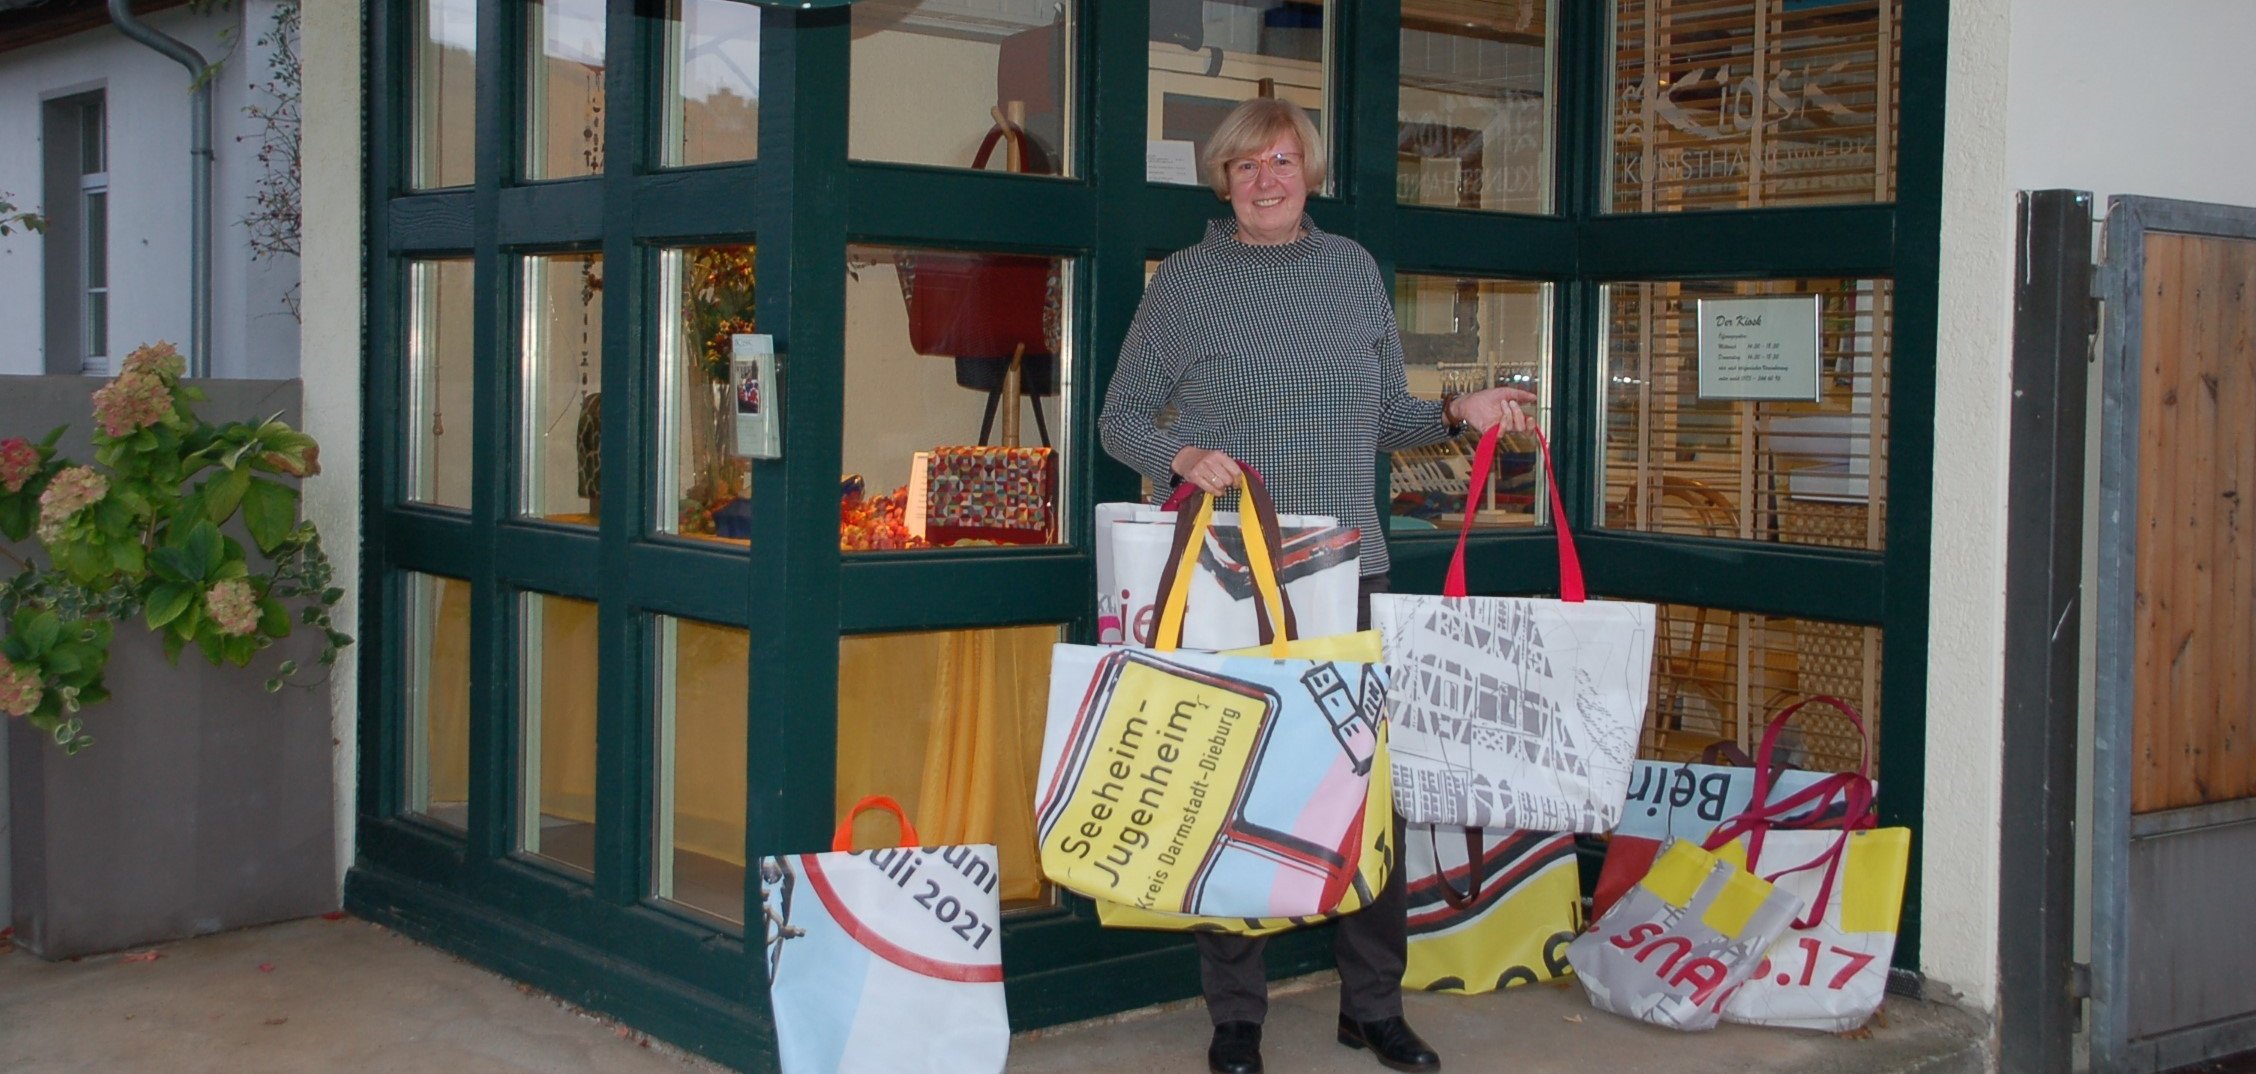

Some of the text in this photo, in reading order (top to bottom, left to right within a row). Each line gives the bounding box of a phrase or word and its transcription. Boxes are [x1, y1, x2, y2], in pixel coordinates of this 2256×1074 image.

[1715, 315, 1762, 327] Der Kiosk
[1060, 699, 1148, 860] Seeheim-
[1093, 697, 1197, 889] Jugenheim
[1134, 707, 1241, 911] Kreis Darmstadt-Dieburg
[846, 848, 993, 951] uli 2021
